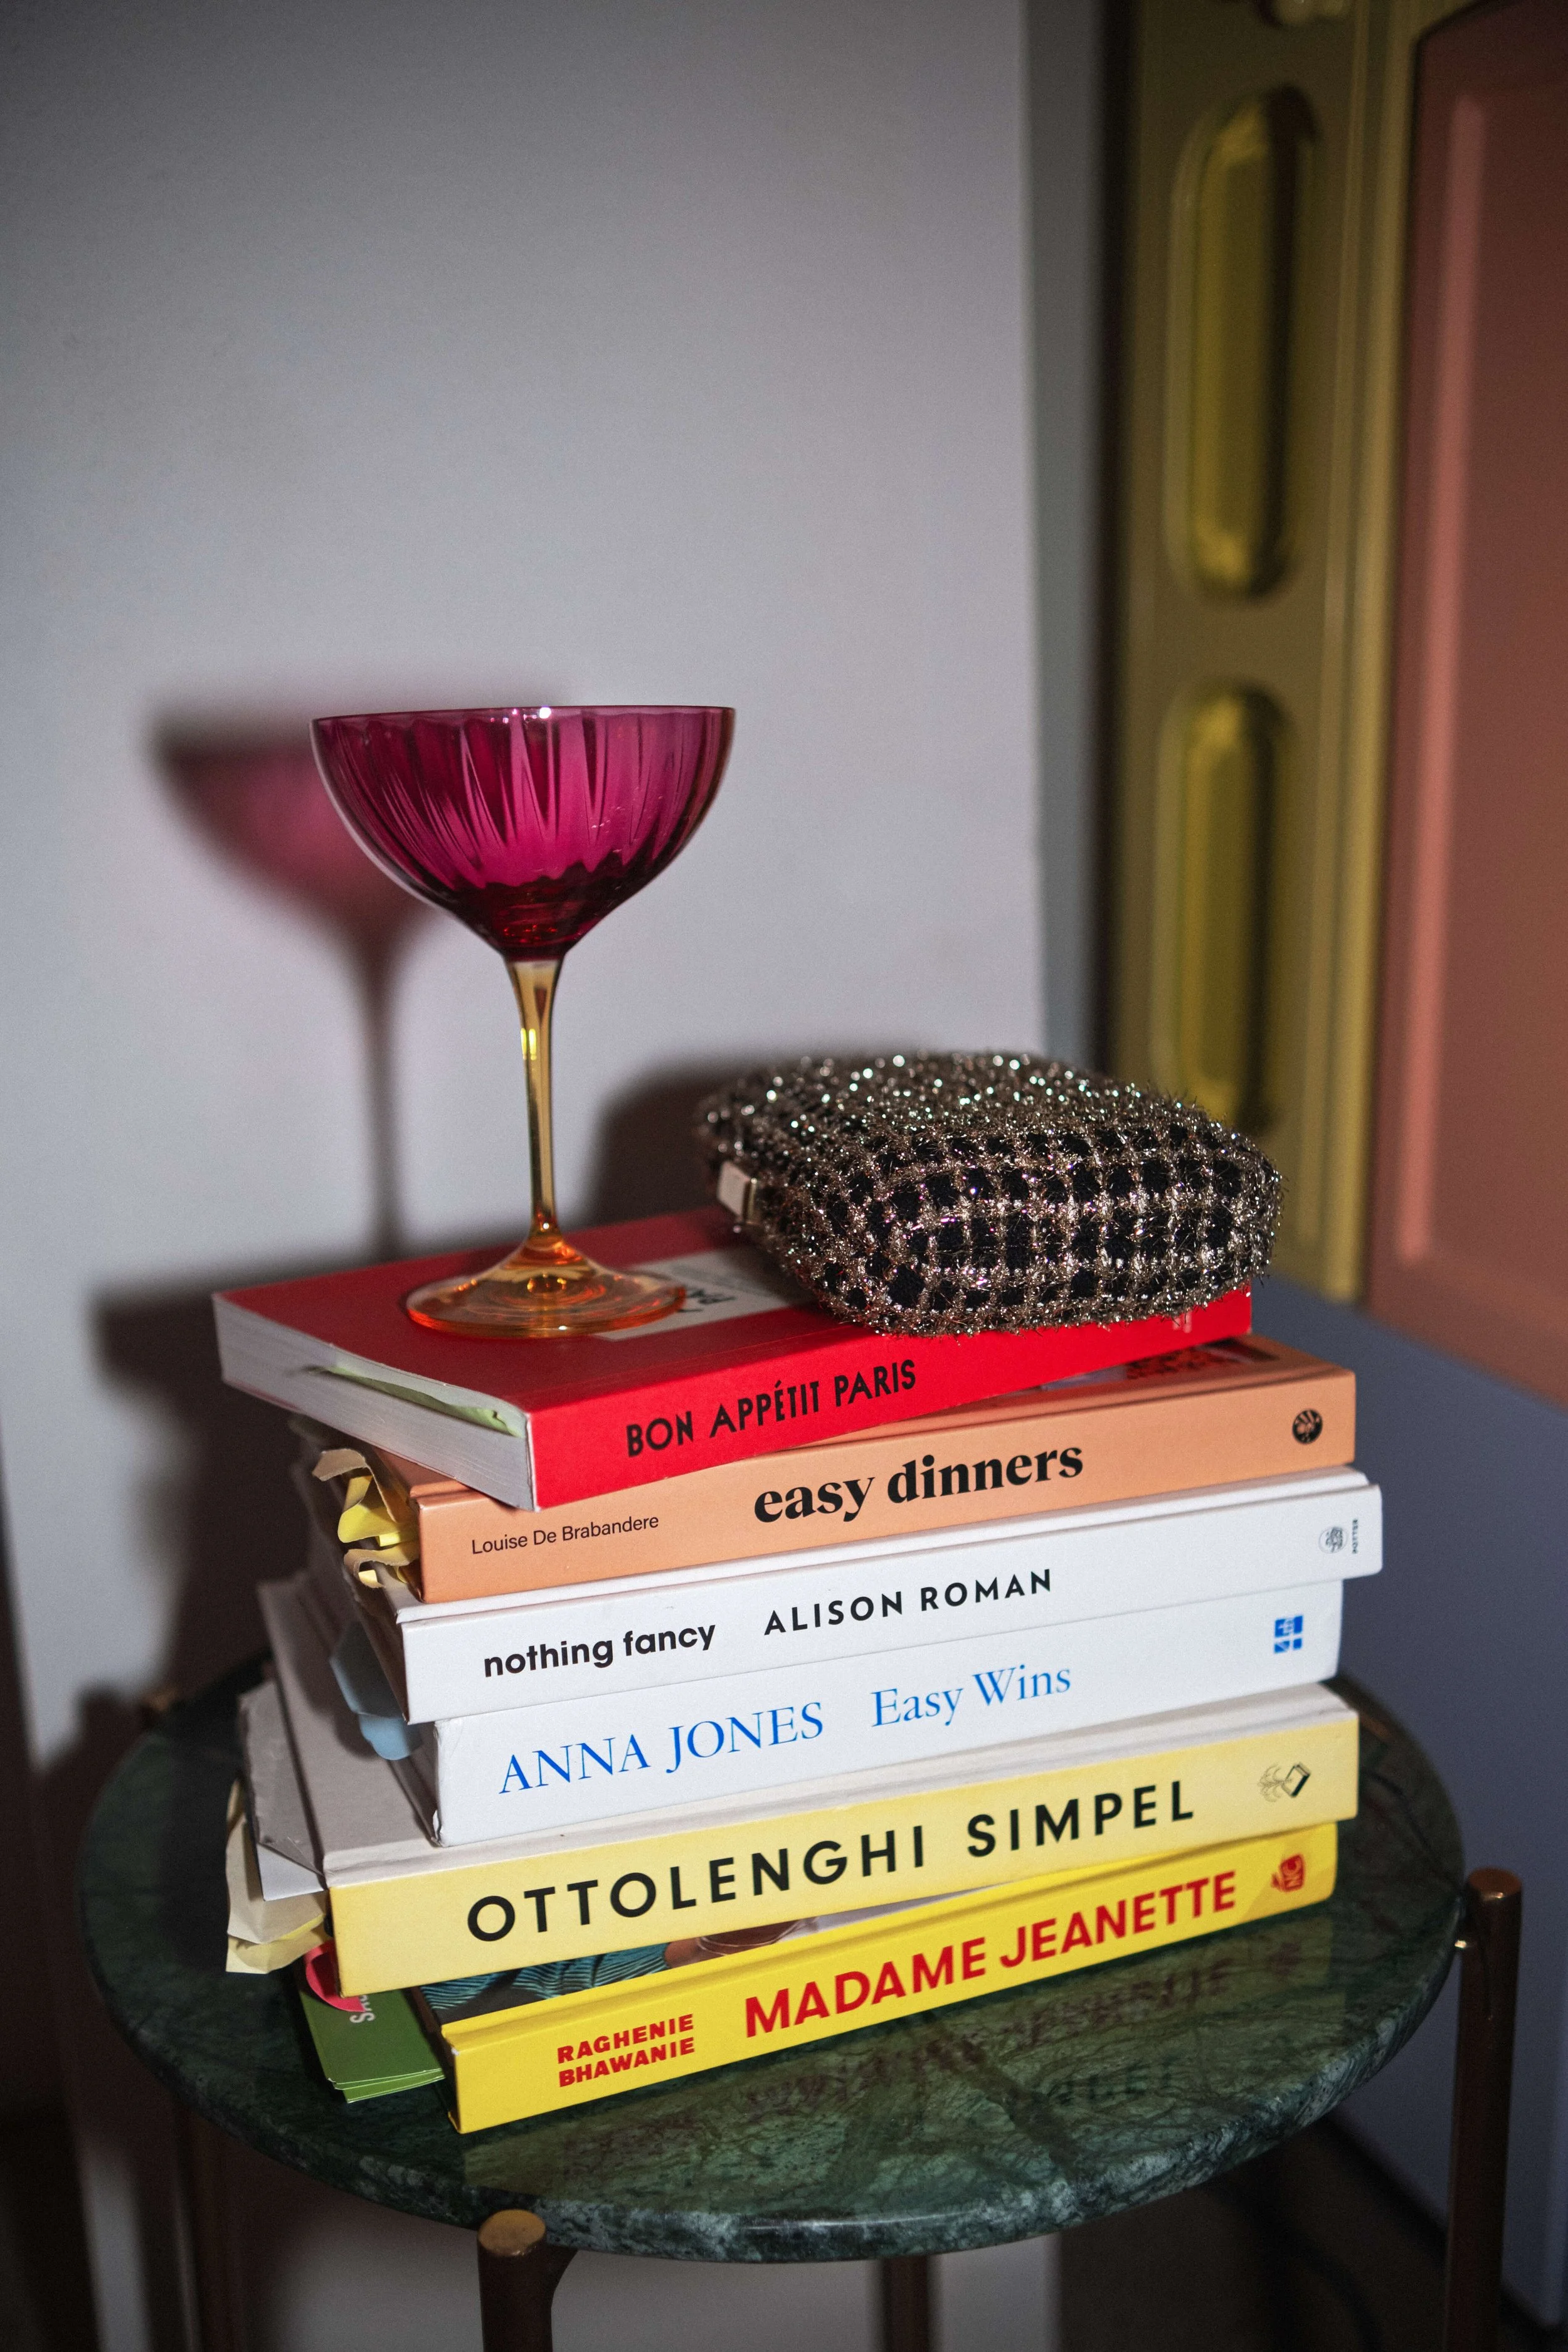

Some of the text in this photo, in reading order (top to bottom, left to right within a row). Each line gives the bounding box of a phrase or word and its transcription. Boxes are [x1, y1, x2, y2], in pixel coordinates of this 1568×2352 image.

[626, 1359, 916, 1457] BON APPÉTIT PARIS
[753, 1446, 1084, 1523] easy dinners
[471, 1515, 659, 1556] Louise De Brabandere
[763, 1568, 1051, 1636] ALISON ROMAN
[484, 1624, 716, 1678] nothing fancy
[871, 1662, 1073, 1728] Easy Wins
[498, 1700, 824, 1796] ANNA JONES
[467, 1780, 1194, 1942] OTTOLENGHI SIMPEL
[745, 1937, 986, 2038] MADAME
[1000, 1870, 1235, 1968] JEANETTE
[557, 2013, 694, 2065] RAGHENIE
[558, 2037, 695, 2088] BHAWANIE
